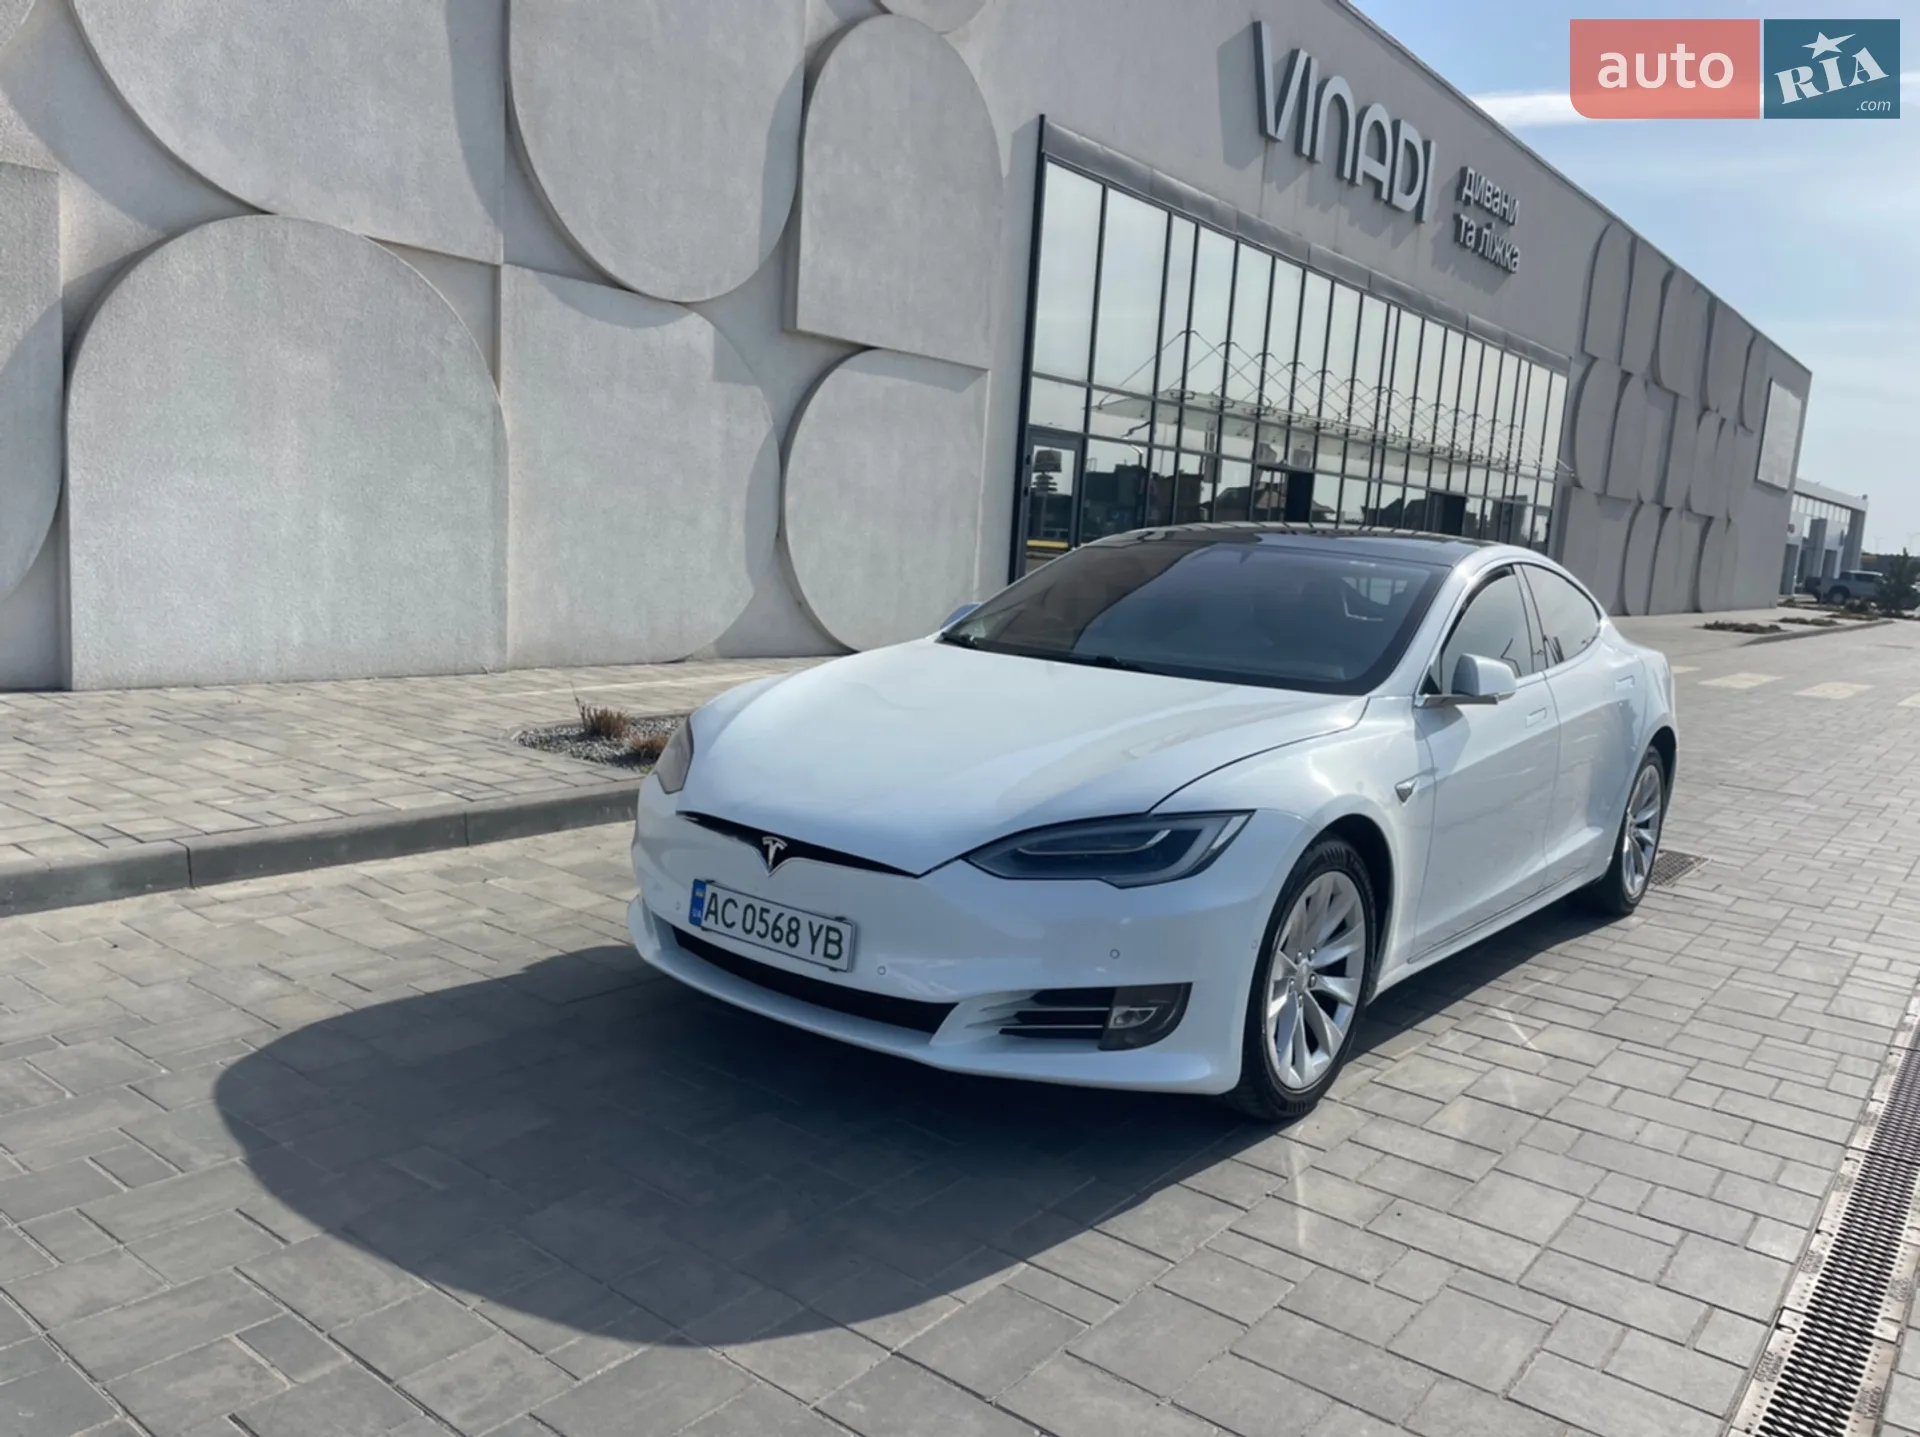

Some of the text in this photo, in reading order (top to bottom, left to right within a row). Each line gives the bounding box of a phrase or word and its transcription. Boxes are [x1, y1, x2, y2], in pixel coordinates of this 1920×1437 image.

[1254, 21, 1436, 224] VINADI
[1461, 166, 1519, 226] дивани
[1459, 213, 1521, 272] та ліжка
